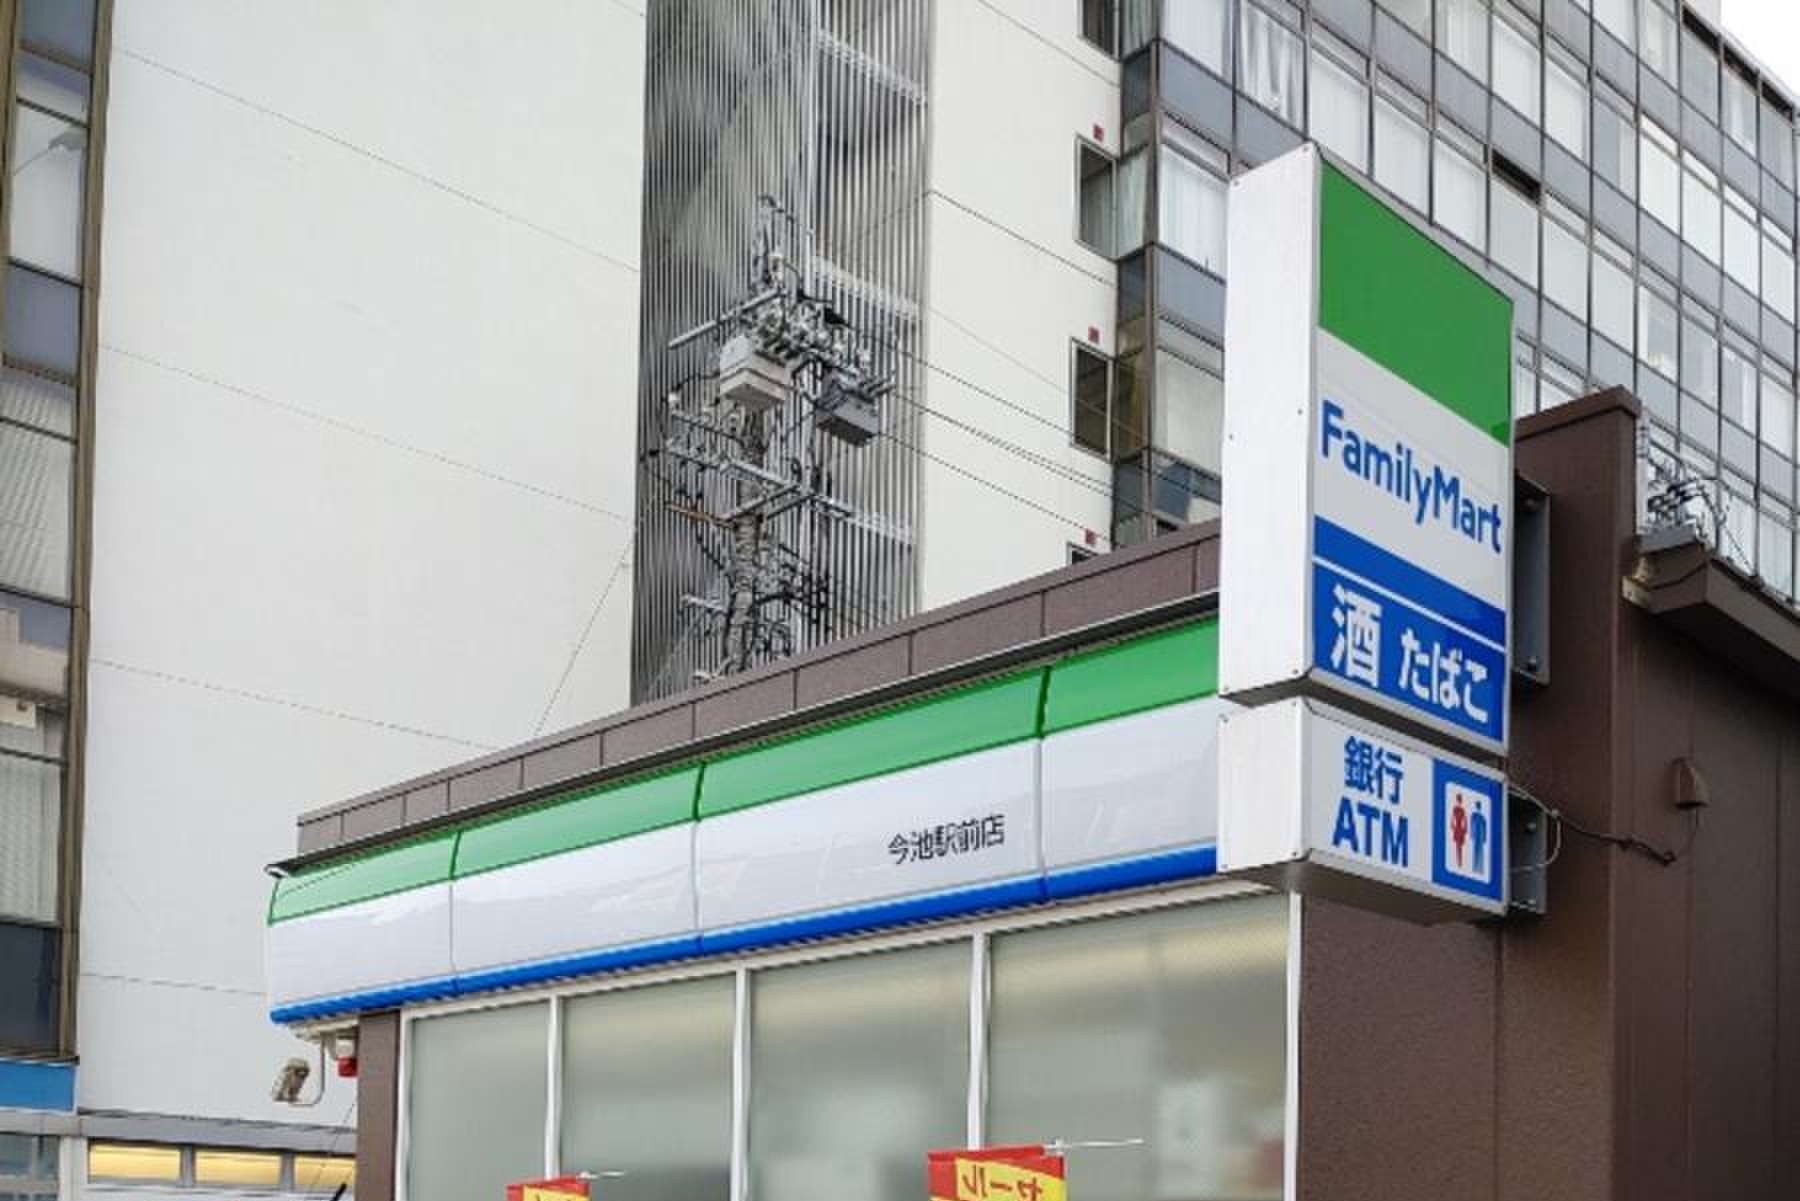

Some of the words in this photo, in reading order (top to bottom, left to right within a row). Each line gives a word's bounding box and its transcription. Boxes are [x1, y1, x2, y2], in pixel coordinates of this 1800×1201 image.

[1321, 399, 1501, 553] FamilyMart
[1331, 583, 1381, 688] 酒
[1400, 626, 1488, 723] たばこ
[1343, 735, 1404, 804] 銀行
[888, 814, 1005, 864] 今池駅前店
[1332, 795, 1408, 868] ATM
